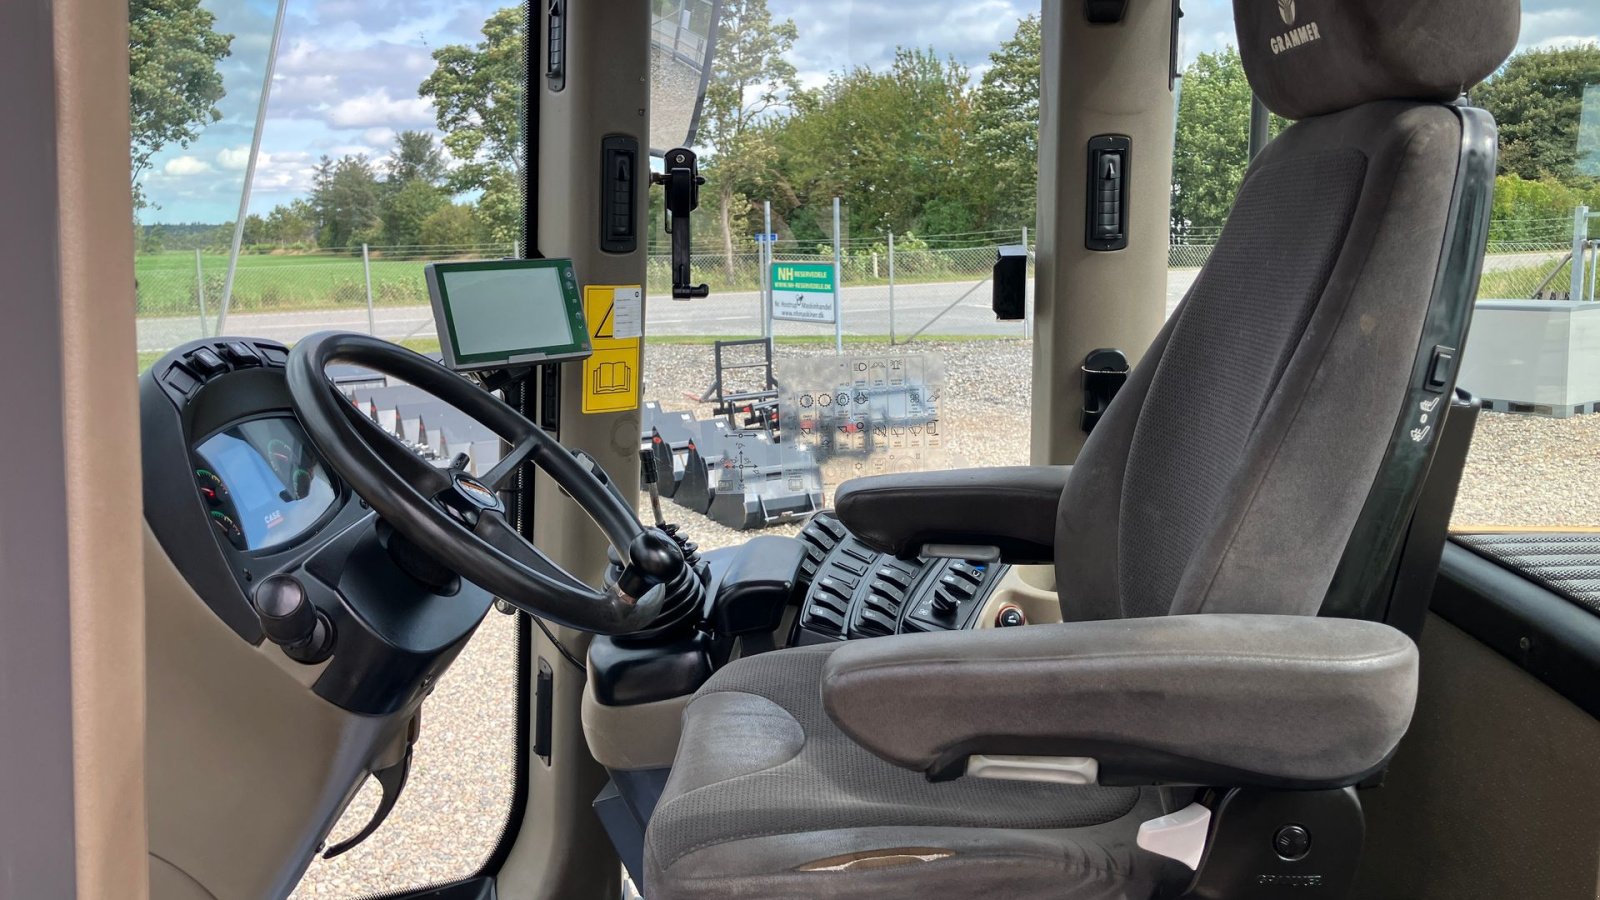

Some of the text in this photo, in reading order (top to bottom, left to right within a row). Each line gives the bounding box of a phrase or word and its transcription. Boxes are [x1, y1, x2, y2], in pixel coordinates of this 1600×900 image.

[1270, 22, 1320, 54] GRAMMER
[778, 267, 794, 280] NH
[264, 509, 281, 524] CASE
